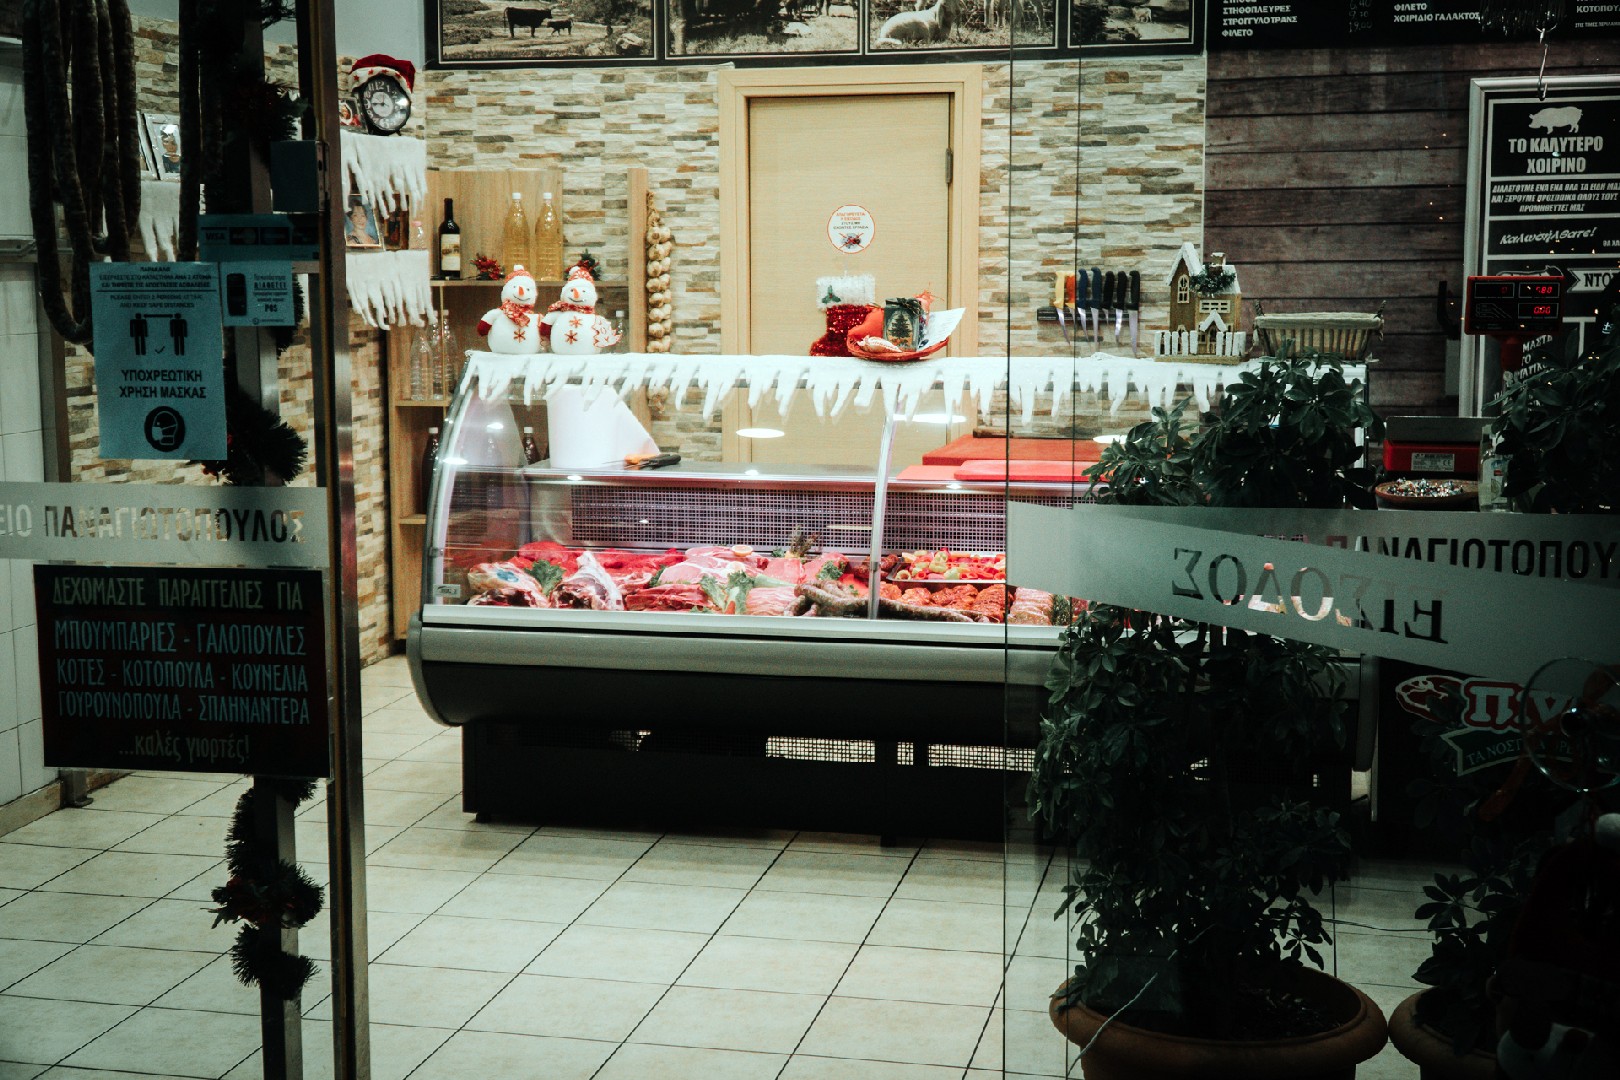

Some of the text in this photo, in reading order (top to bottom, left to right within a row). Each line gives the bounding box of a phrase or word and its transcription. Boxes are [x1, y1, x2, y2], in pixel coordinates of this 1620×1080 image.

[1222, 5, 1291, 15] ΣΤΗΘΟΠΛΕΥΡΕΣ
[1393, 3, 1427, 12] ΦΙΛΕΤΟ
[1576, 4, 1620, 14] ΚΟΤΟΠΟΥ
[1393, 12, 1480, 23] ΧΟΙΡΙΔΙΟ ΓΑΛΑΚΤΟΣ
[1221, 28, 1254, 37] ΦΙΛΕΤΟ
[1508, 135, 1604, 154] ΤΟ ΚΑΛΥΤΕΡΟ
[1526, 156, 1587, 174] ΧΟΙΡΙΝΟ
[121, 369, 202, 382] ΥΠΟΧΡΕΩΤΙΚΗ
[119, 386, 207, 399] ΧΡΗΣΗ ΜΑΣΚΑΣ
[53, 576, 303, 611] ΔΕΧΟΜΑΣΤΕ ΠΑΡΑΓΓΕΛΙΕΣ ΓΙΑ
[54, 620, 177, 653] ΜΠΟΥΜΠΑΡΙΕΣ
[196, 623, 307, 656] ΓΑΛΟΠΟΥΛΕΣ
[56, 658, 105, 686] ΚΟΤΕΣ
[122, 660, 215, 689] ΚΟΤΟΠΟΥΛΑ
[232, 663, 309, 693] ΚΟΥΝΕΛΙΑ
[58, 691, 182, 720] ΓΟΥΡΟΥΝΟΠΟΥΛΑ
[198, 695, 311, 725] ΣΠΛΗΝΑΝΤΕΡΑ
